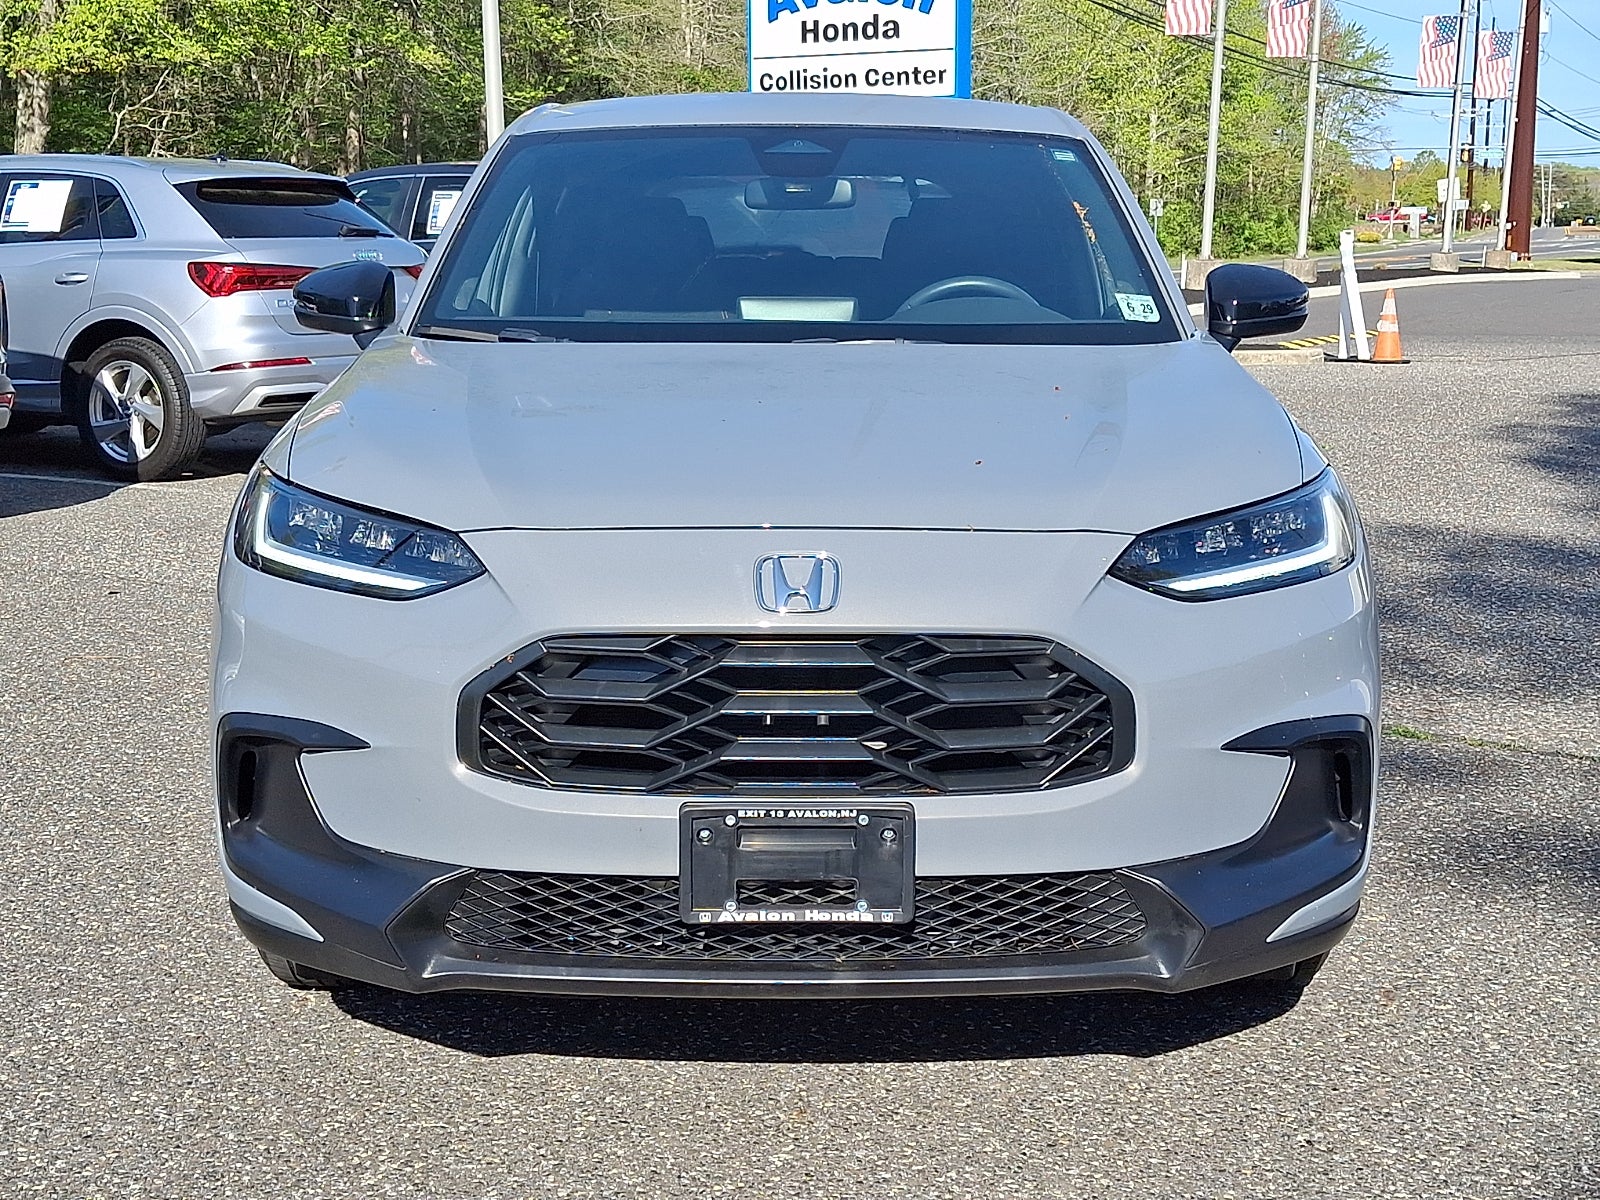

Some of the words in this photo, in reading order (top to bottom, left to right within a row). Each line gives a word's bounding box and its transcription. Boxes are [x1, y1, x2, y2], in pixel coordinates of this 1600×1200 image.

[801, 14, 899, 44] Honda
[760, 68, 857, 92] Collision
[865, 66, 947, 87] Center
[1127, 302, 1135, 312] 6
[1140, 303, 1154, 314] 29
[738, 809, 766, 818] EXIT
[717, 909, 796, 923] Avalon
[805, 909, 874, 922] Honda
